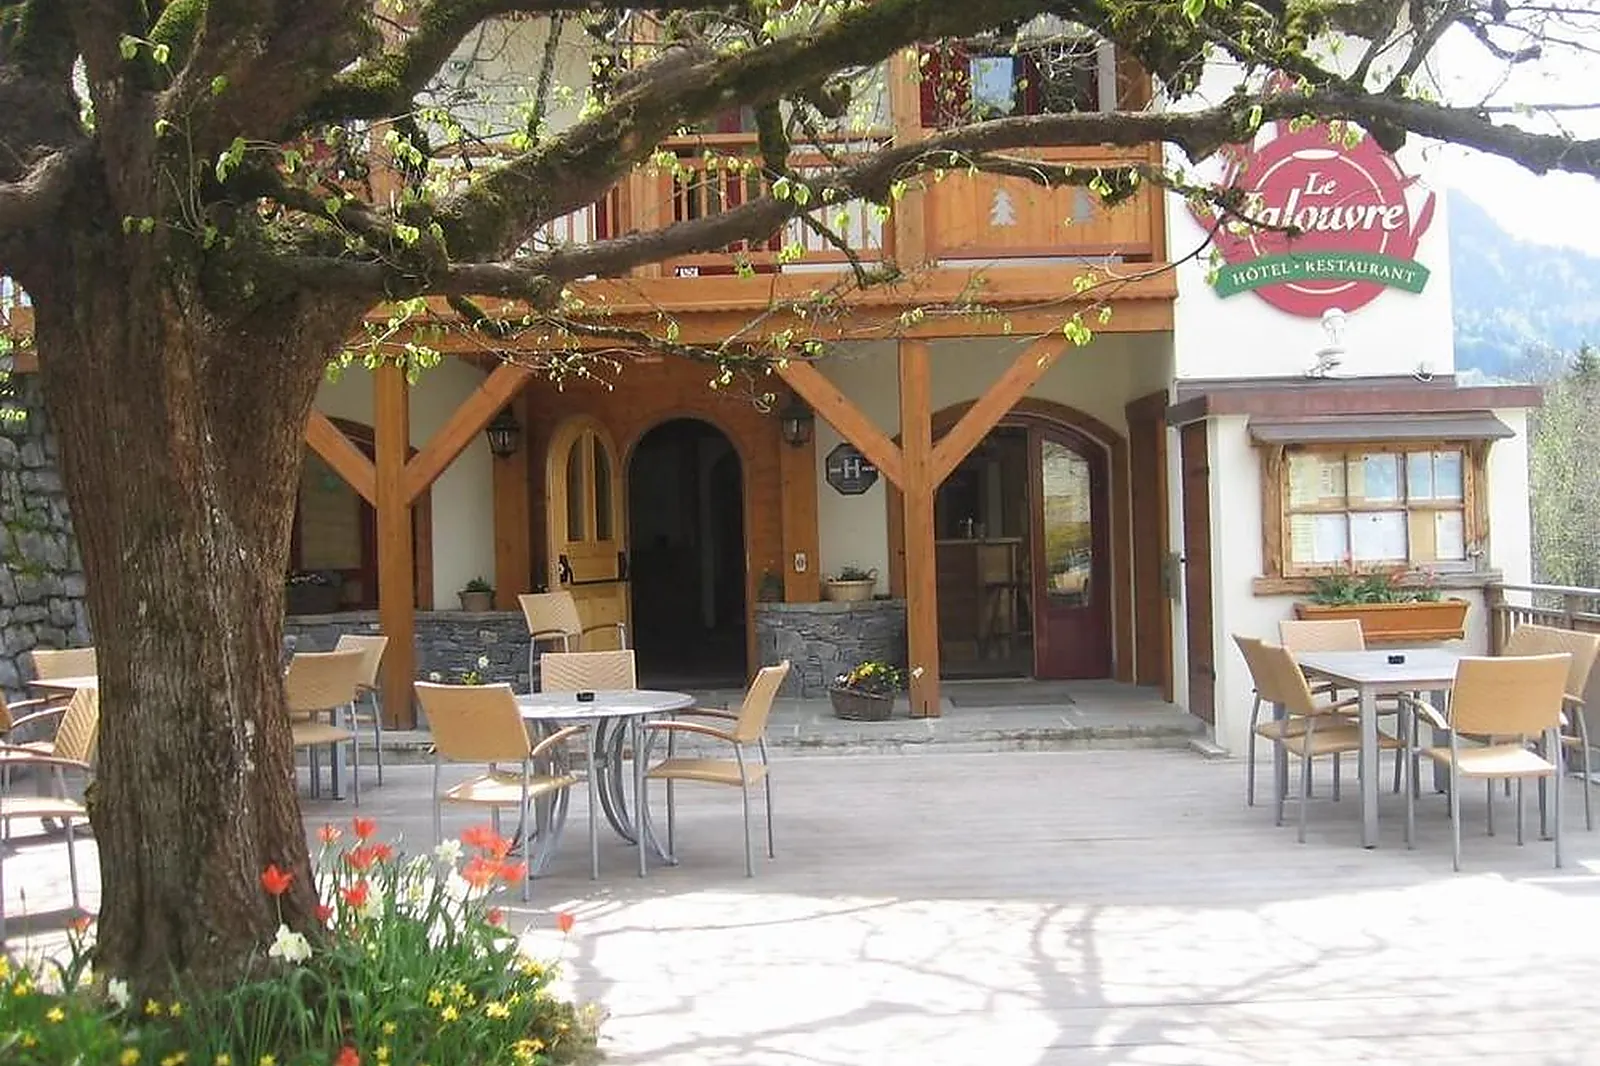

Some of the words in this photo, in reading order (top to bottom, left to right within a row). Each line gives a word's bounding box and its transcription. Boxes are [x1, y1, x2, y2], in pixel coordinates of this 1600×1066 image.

[1304, 171, 1337, 195] Le
[1305, 260, 1415, 283] RESTAURANT
[844, 459, 860, 479] H
